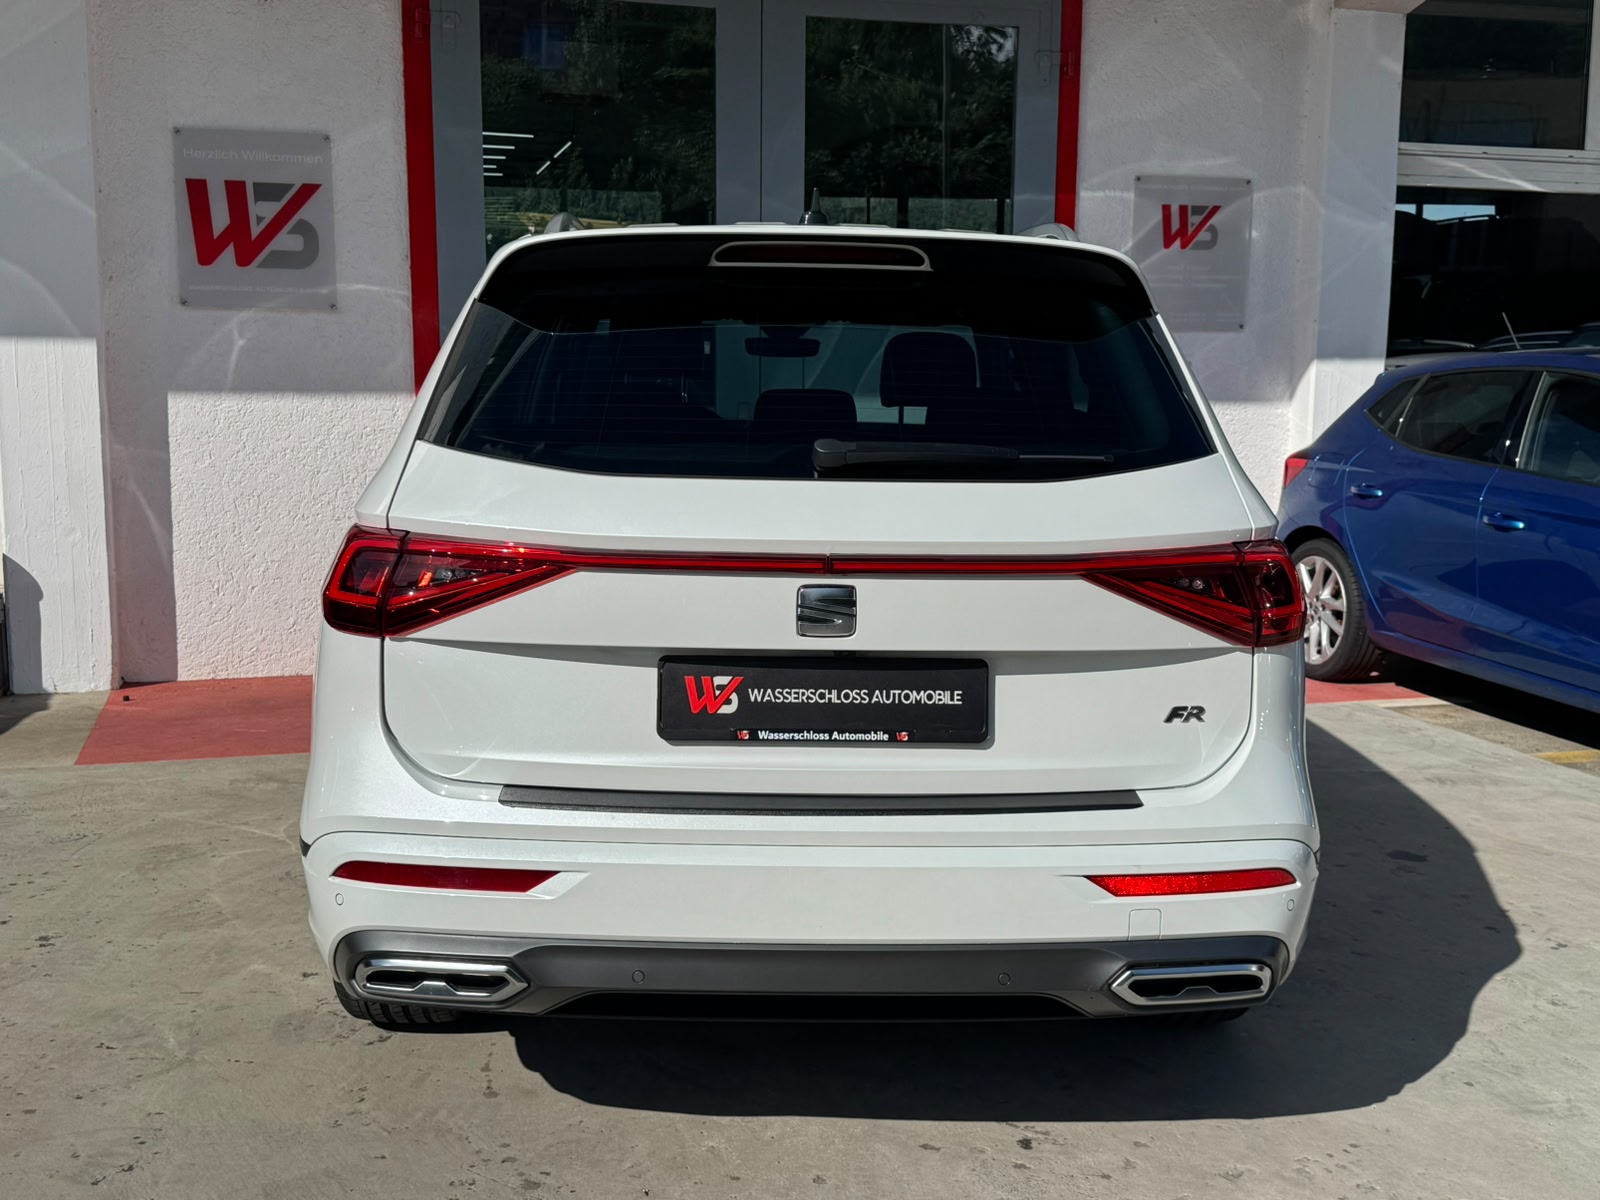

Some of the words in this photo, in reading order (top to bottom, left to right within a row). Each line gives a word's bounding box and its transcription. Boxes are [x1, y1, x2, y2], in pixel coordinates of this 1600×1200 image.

[183, 148, 239, 160] Herzlich
[241, 149, 323, 164] Willkommen
[748, 688, 869, 704] WASSERSCHLOSS
[871, 689, 963, 705] AUTOMOBILE
[1163, 705, 1206, 724] FR
[758, 730, 829, 740] Wasserschloss
[831, 731, 889, 741] Automobile
